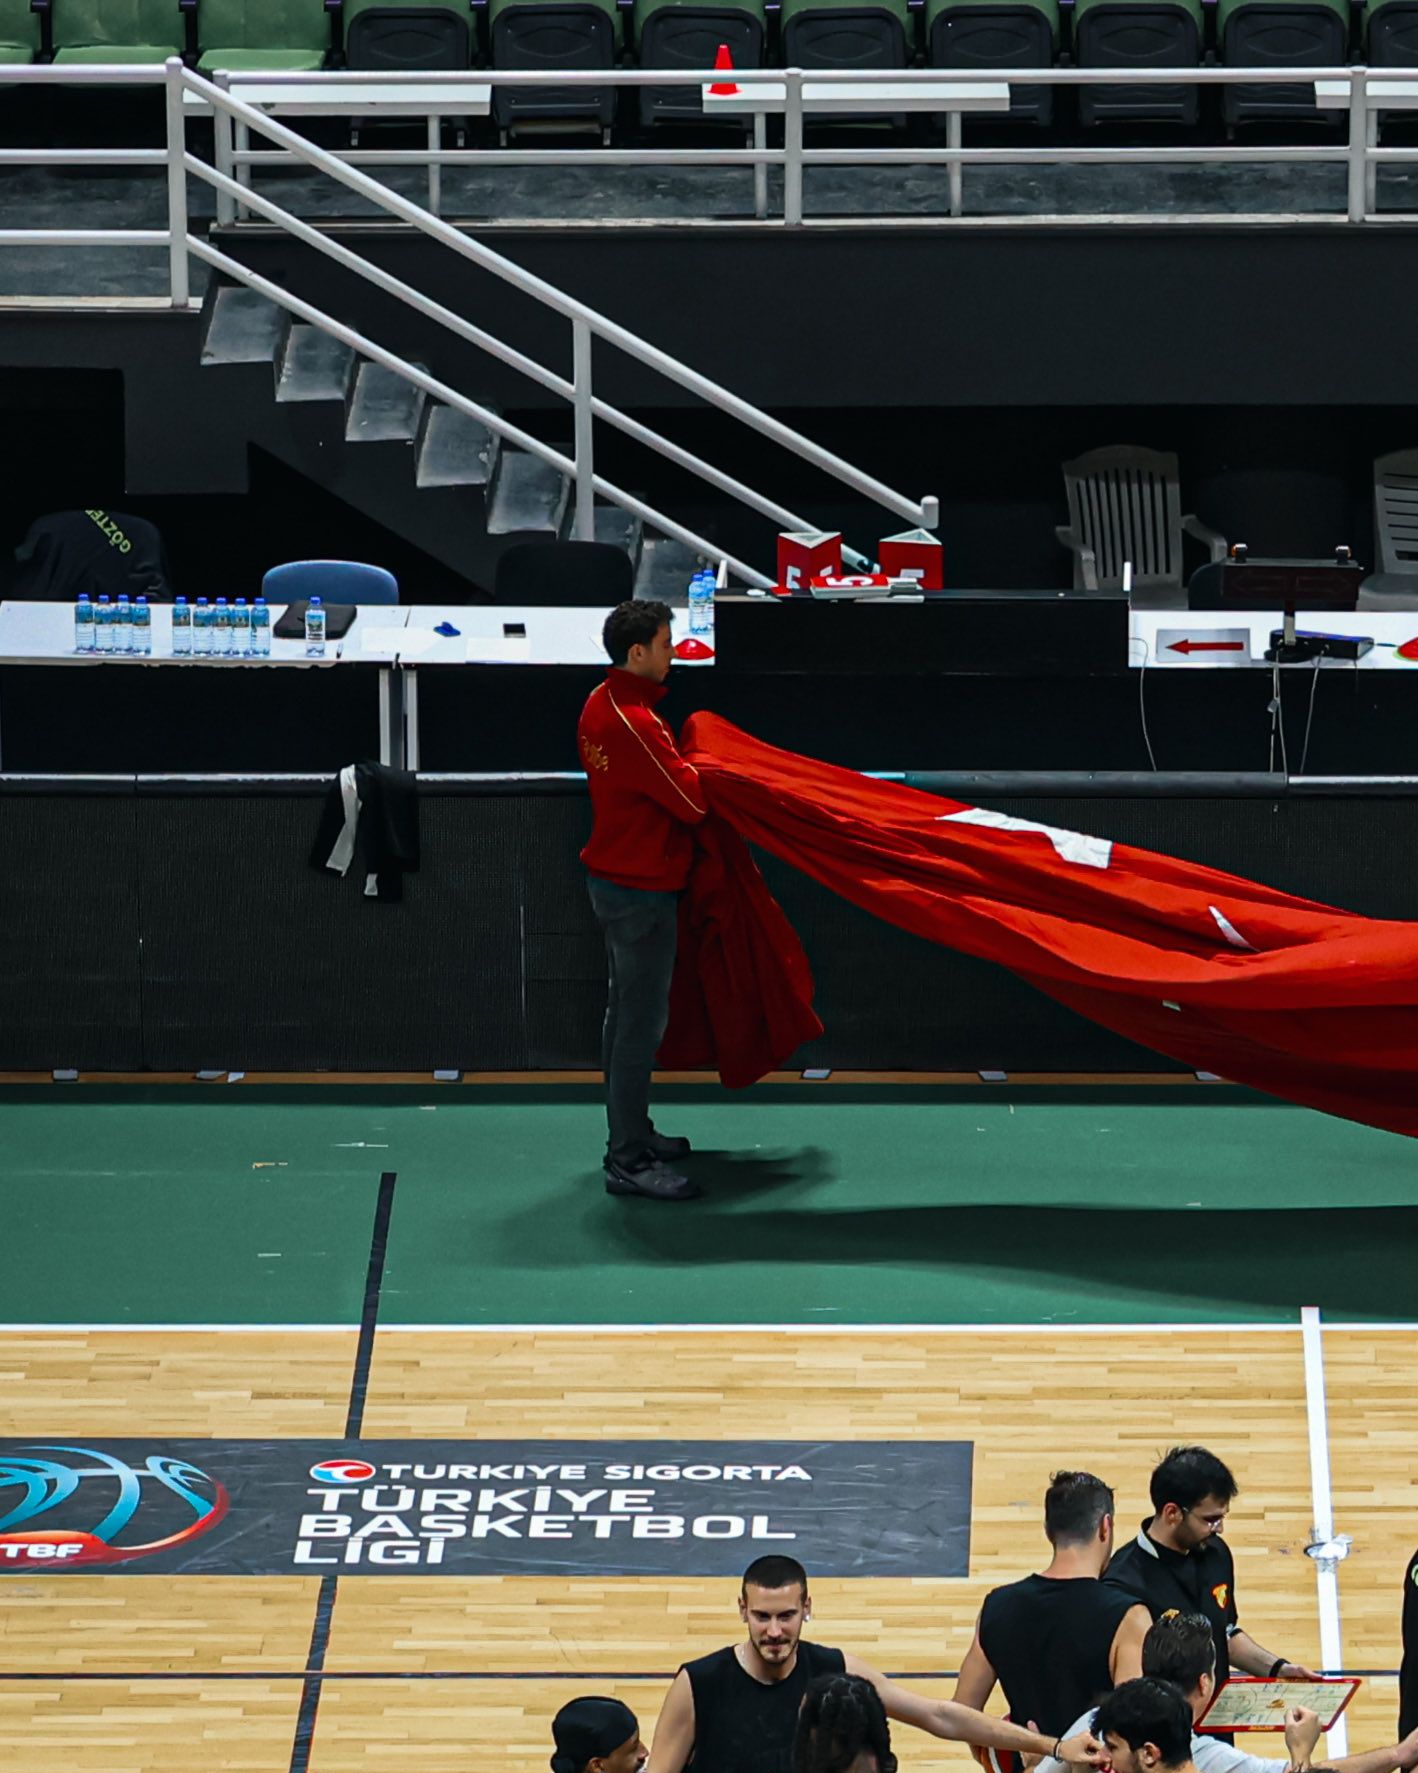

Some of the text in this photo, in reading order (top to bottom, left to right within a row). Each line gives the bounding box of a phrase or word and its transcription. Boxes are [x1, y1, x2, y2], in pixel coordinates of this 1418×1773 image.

[603, 1464, 813, 1481] SIGORTA
[306, 1485, 656, 1512] TÜRKİYE
[298, 1514, 796, 1539] BASKETBOL
[0, 1543, 84, 1559] TBF
[293, 1536, 445, 1564] LİGİ
